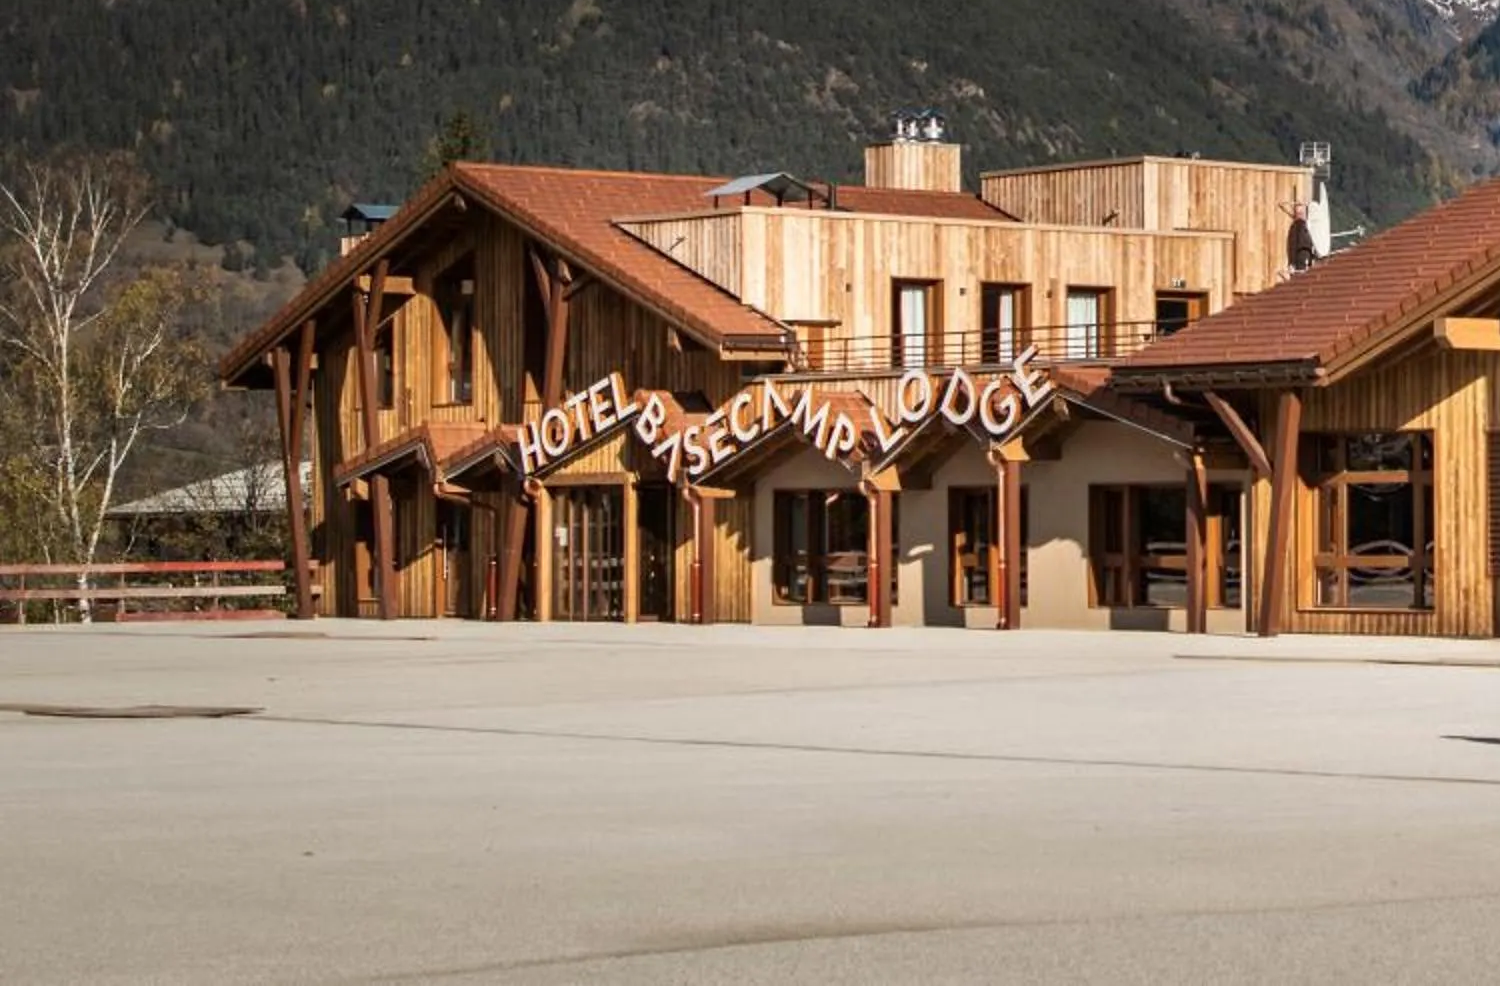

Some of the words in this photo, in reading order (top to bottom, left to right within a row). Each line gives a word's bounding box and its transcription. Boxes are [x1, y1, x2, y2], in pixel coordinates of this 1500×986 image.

[517, 371, 641, 473] HOTEL
[635, 377, 858, 483] BASECAMP
[869, 343, 1056, 453] LODGE
